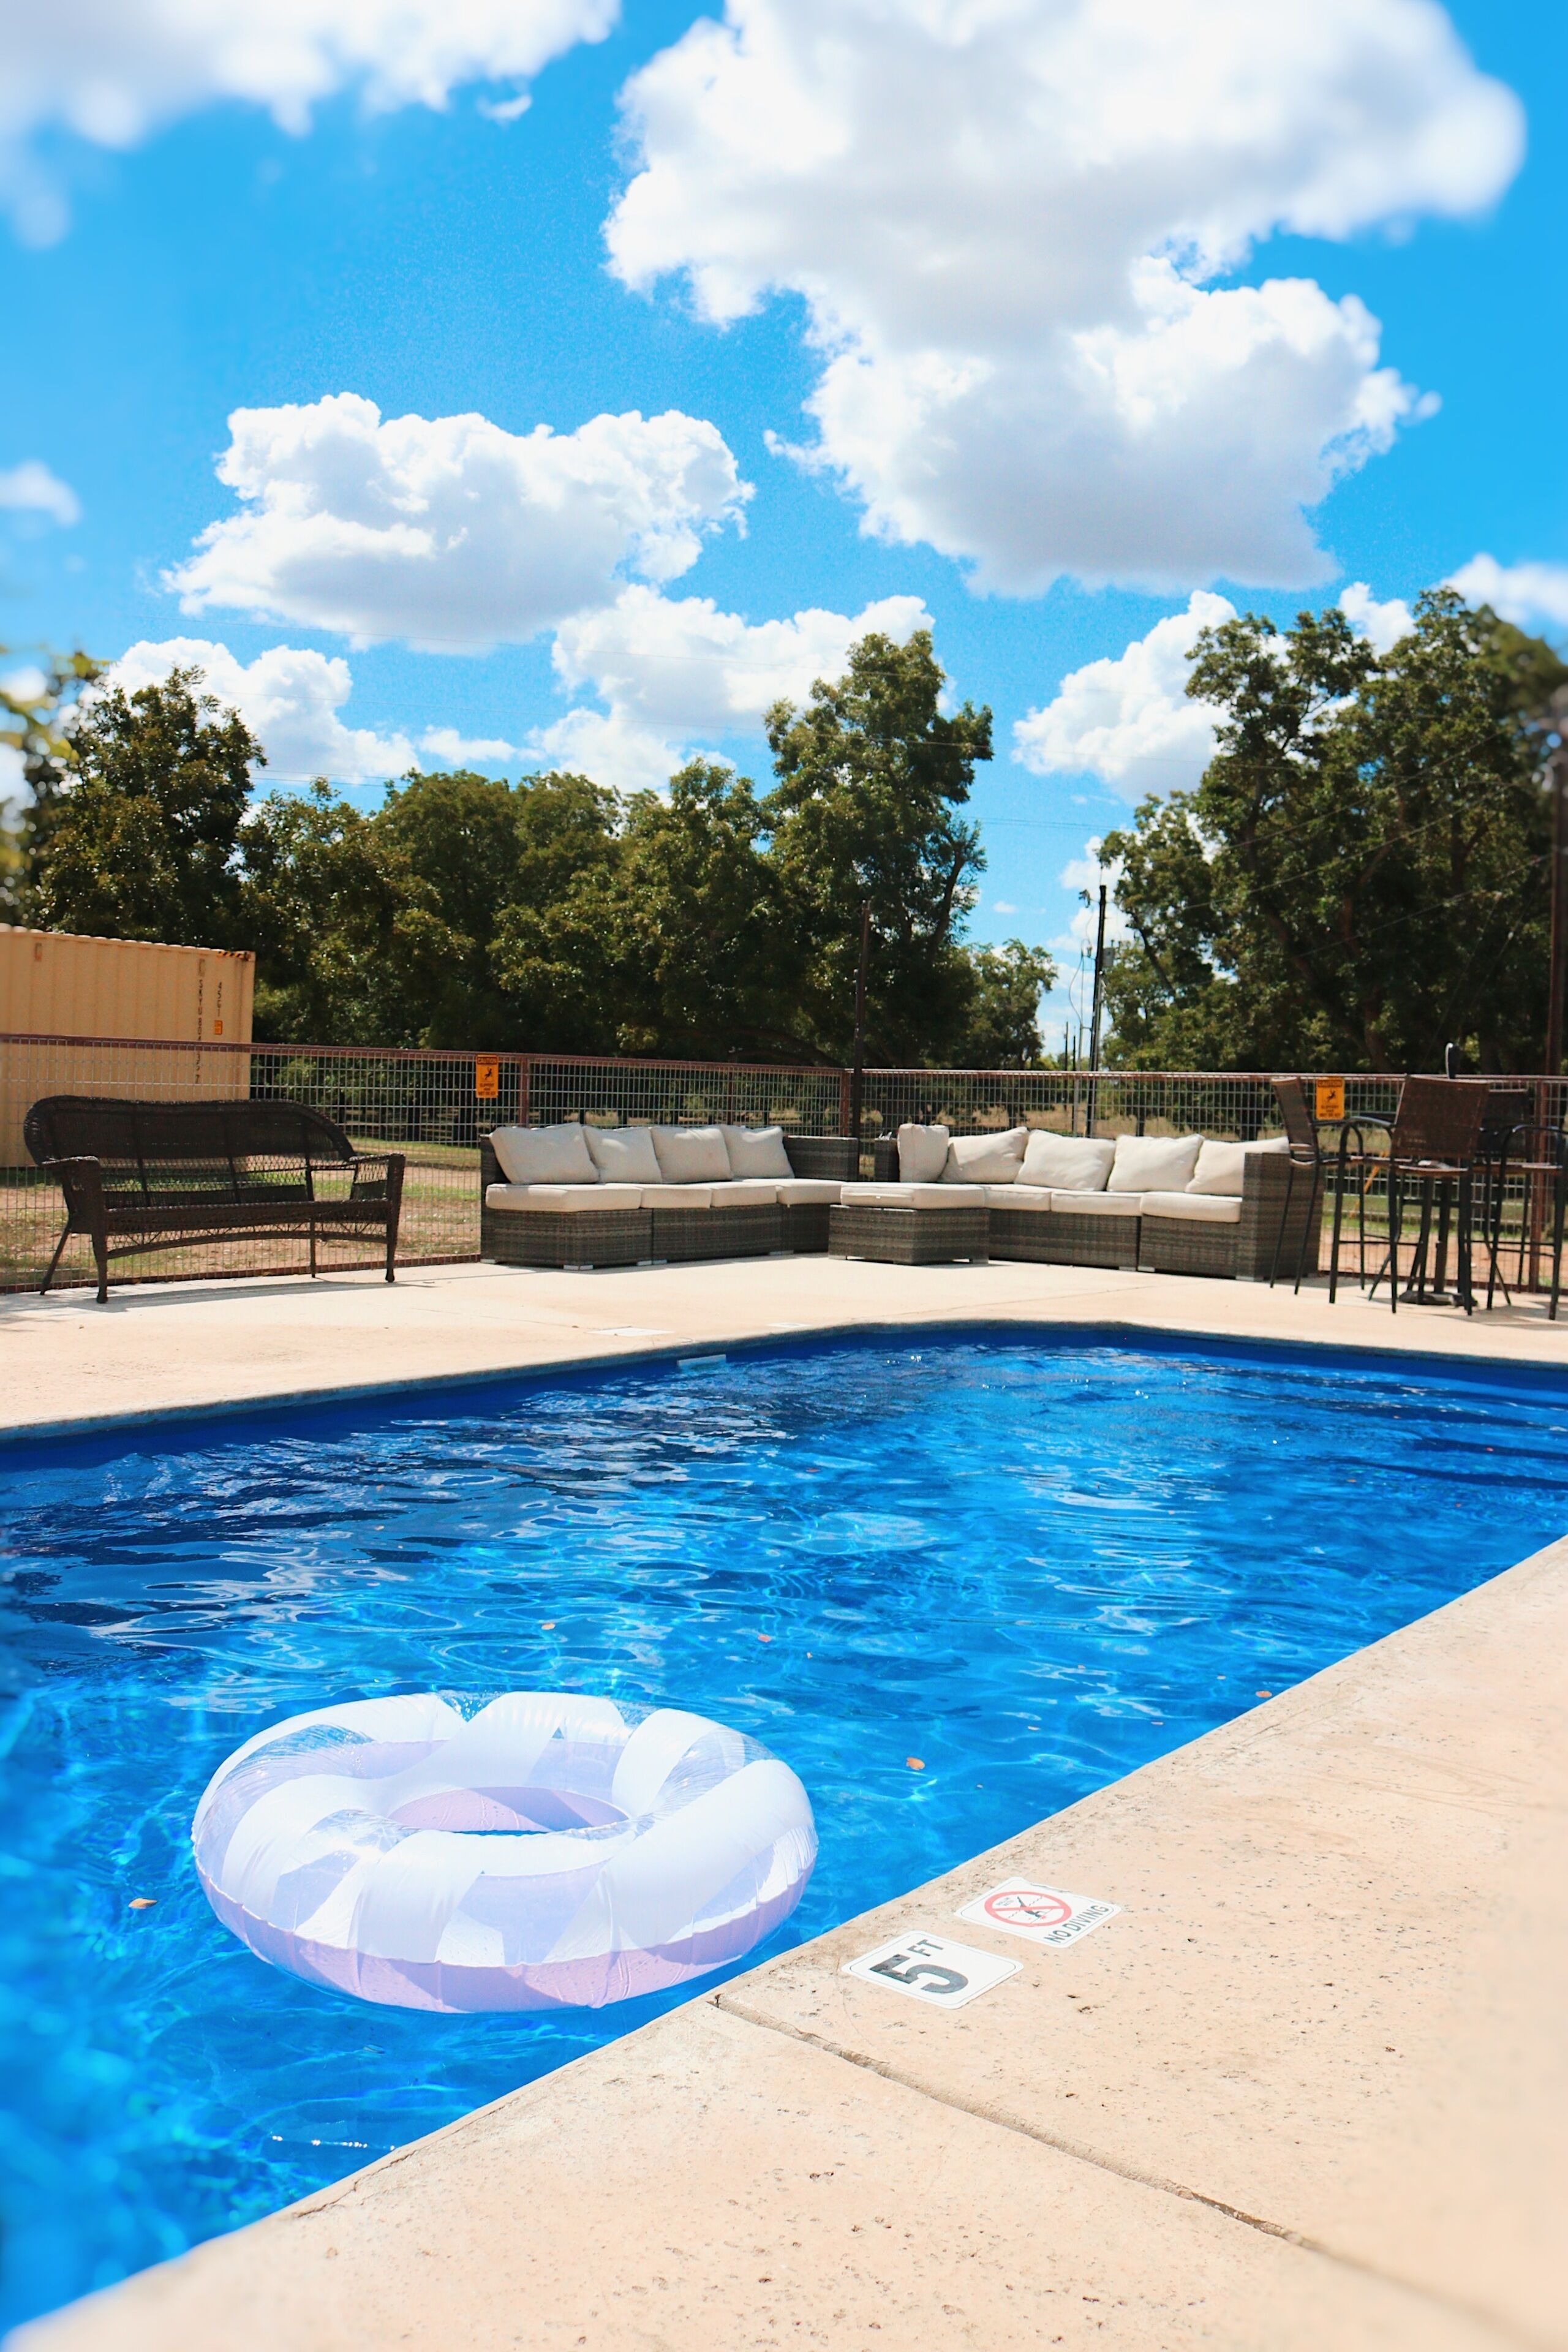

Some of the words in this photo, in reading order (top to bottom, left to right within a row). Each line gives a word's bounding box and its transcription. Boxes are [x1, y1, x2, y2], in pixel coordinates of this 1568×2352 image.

[1044, 1930, 1072, 1943] NO
[1062, 1905, 1109, 1931] DIVING
[908, 1939, 944, 1957] FT
[869, 1954, 969, 1994] 5
